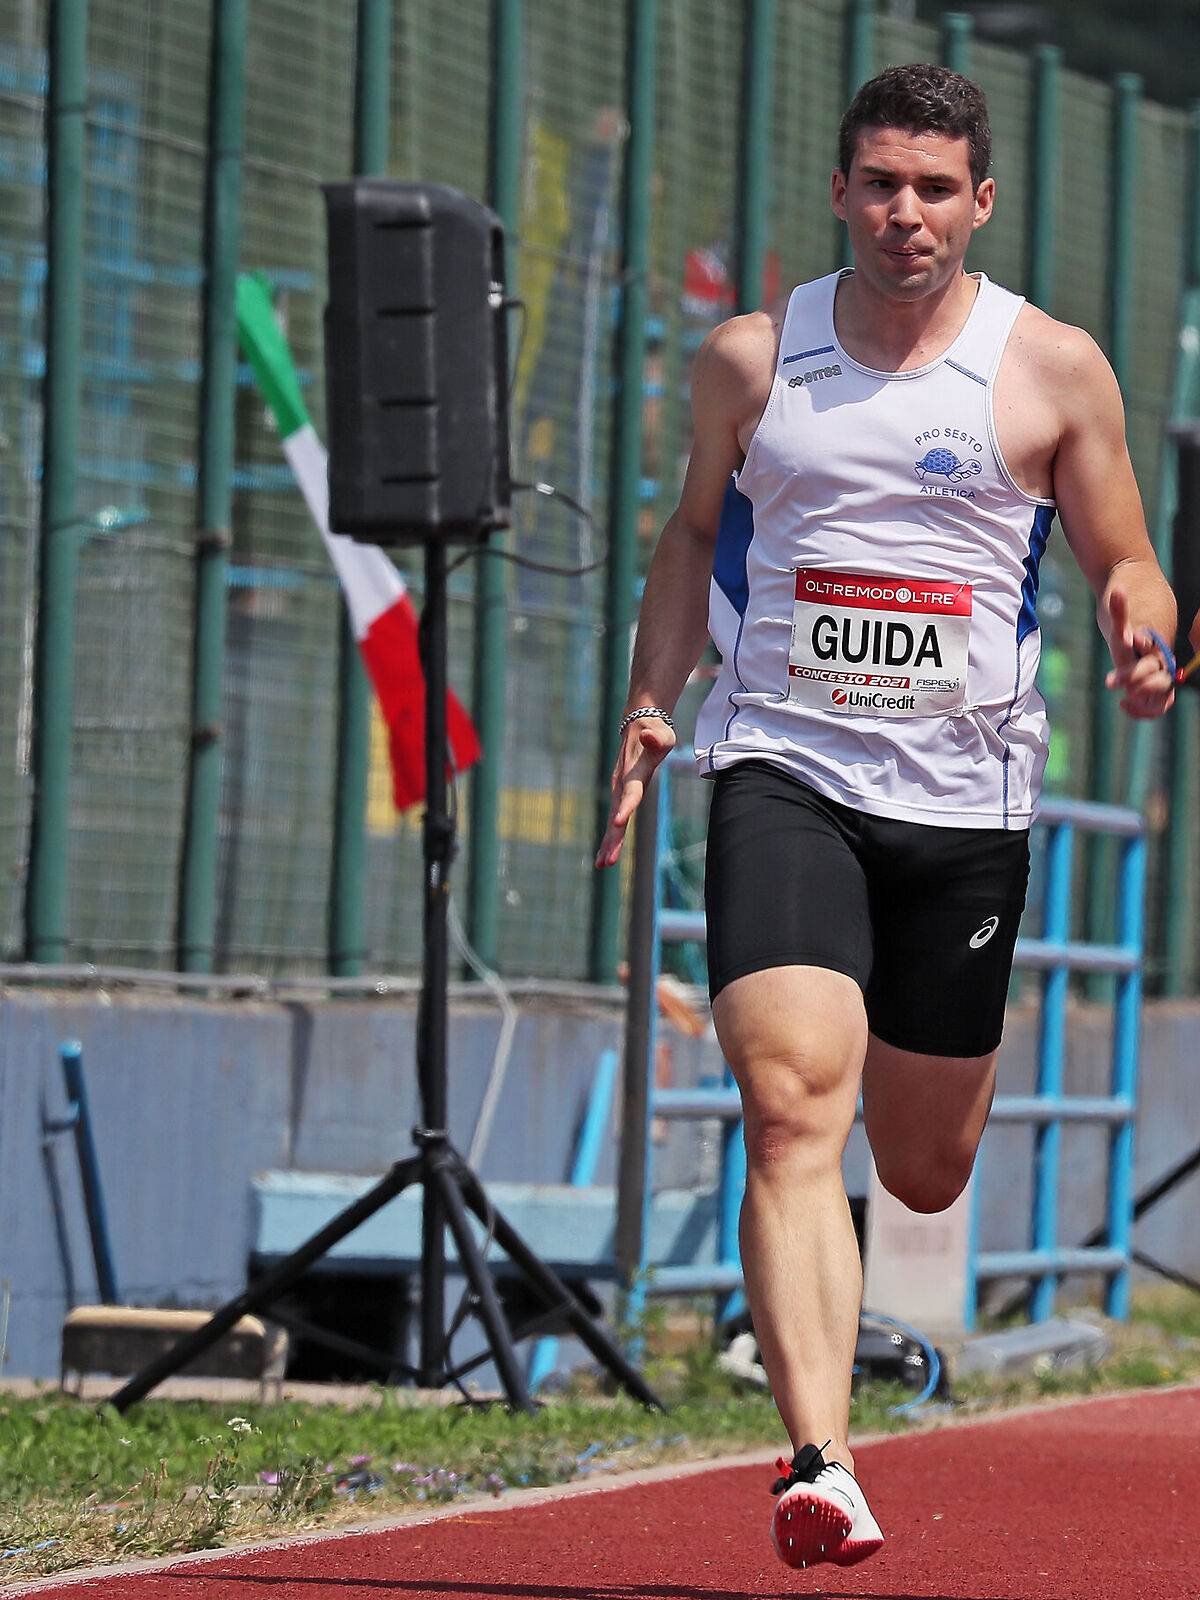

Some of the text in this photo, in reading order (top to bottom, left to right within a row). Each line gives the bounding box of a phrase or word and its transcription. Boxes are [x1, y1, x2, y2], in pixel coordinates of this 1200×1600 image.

[914, 427, 983, 453] PRO SESTO
[920, 485, 976, 499] ATLETICA
[811, 614, 943, 668] GUIDA
[794, 667, 909, 688] CONCESIO 2021
[849, 691, 916, 710] UniCredit
